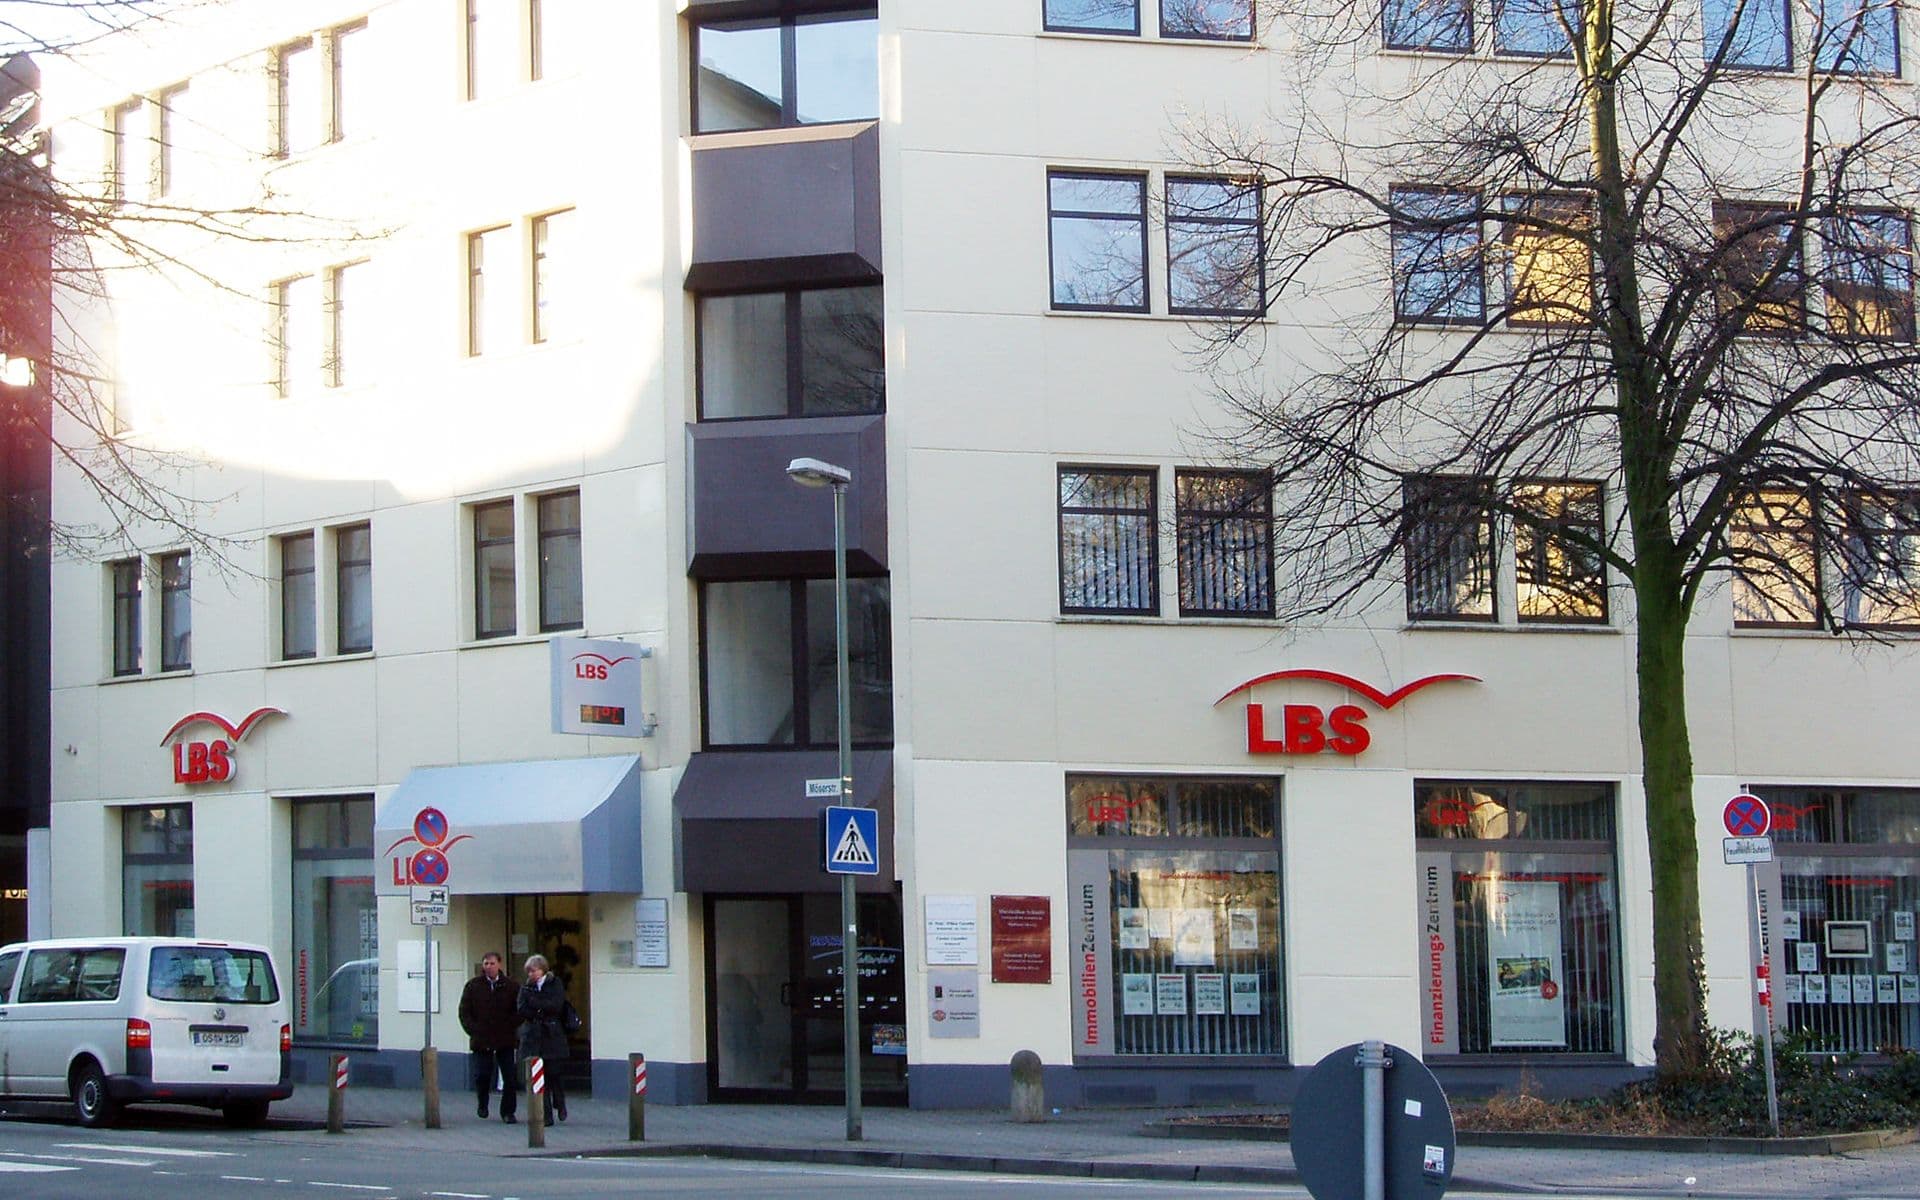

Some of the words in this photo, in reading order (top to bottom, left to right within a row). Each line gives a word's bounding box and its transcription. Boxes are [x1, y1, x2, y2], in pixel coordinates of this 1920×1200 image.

[576, 663, 608, 680] LBS
[1246, 703, 1371, 755] LBS
[173, 739, 237, 784] LBS
[1088, 806, 1127, 822] LBS
[1430, 808, 1469, 826] LBS
[1772, 814, 1797, 831] BS
[1426, 866, 1446, 1045] FinanzierungsZentrum
